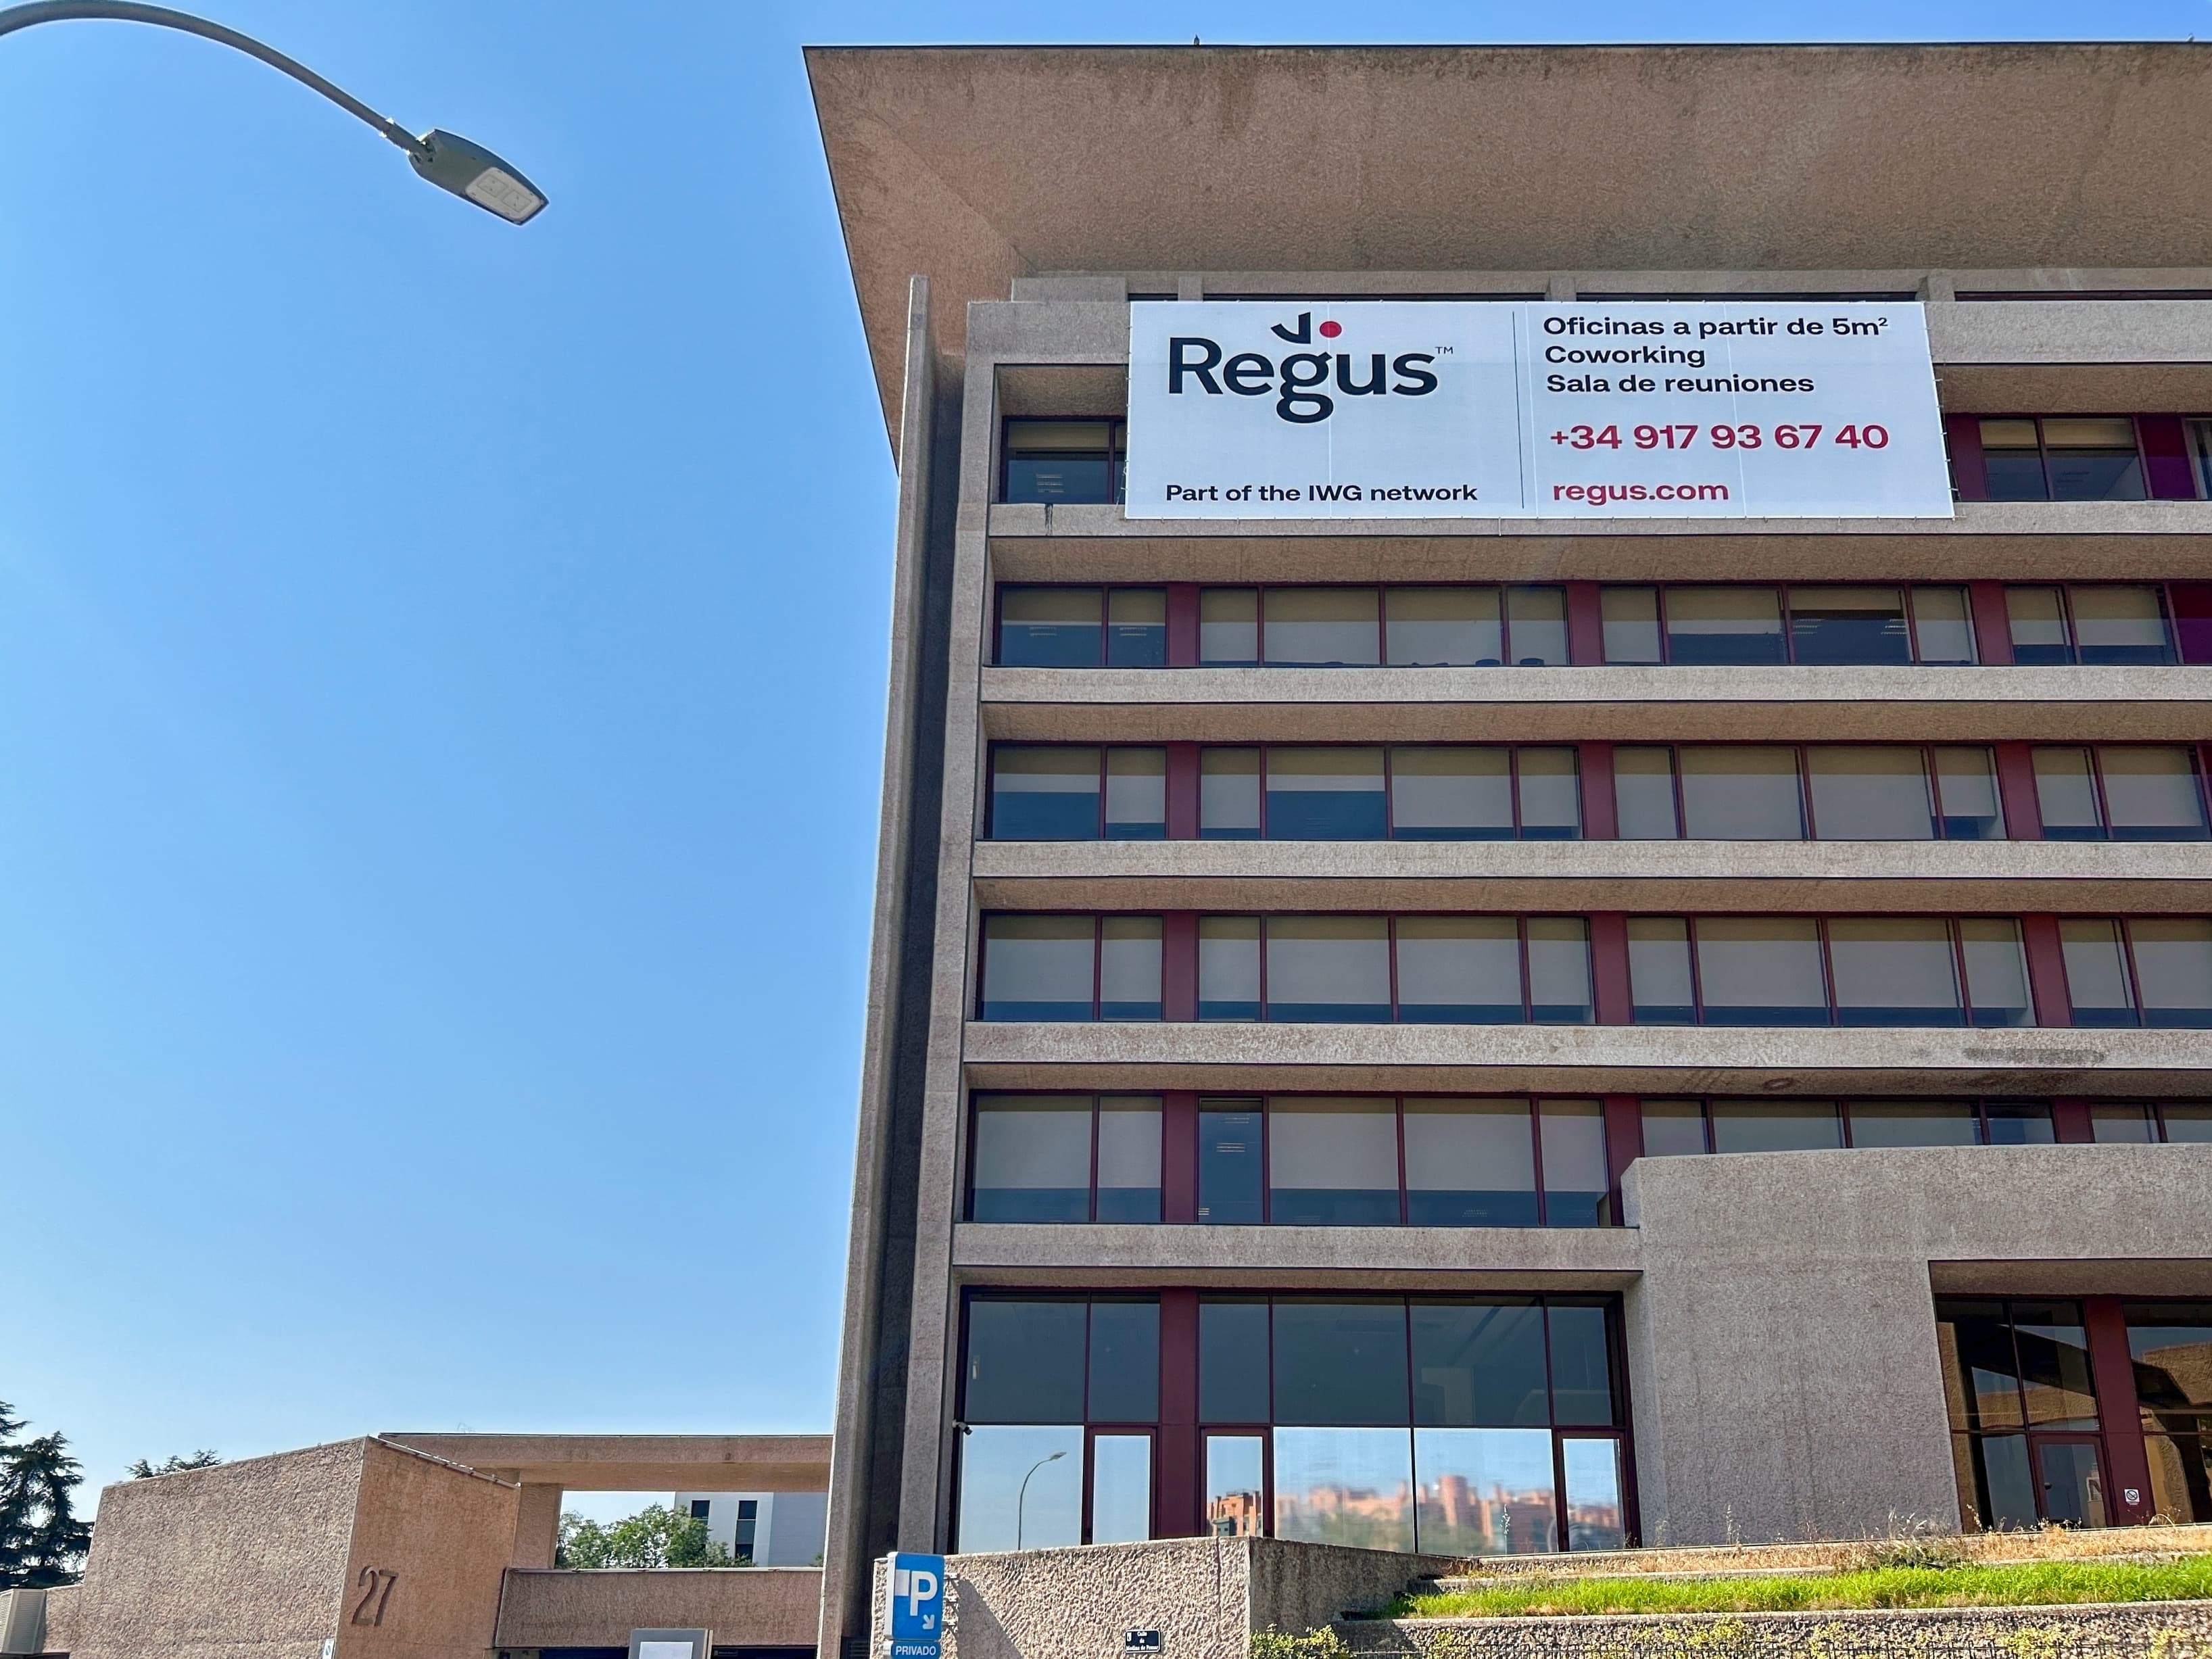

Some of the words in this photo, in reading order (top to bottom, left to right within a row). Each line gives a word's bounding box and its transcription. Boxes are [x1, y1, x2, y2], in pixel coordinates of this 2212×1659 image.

[1543, 316, 1664, 335] Oficinas
[1673, 322, 1691, 335] a
[1699, 317, 1778, 340] partir
[1787, 317, 1824, 335] de
[1832, 317, 1888, 336] 5m²
[1545, 345, 1706, 368] Coworking
[1547, 374, 1611, 393] Sala
[1618, 374, 1656, 392] de
[1664, 373, 1814, 392] reuniones
[1550, 425, 1622, 450] +34
[1633, 425, 1698, 450] 917
[1710, 425, 1762, 450] 93
[1774, 425, 1823, 449] 67
[1835, 425, 1889, 449] 40
[1166, 484, 1219, 501] Part
[1225, 484, 1252, 501] of
[1257, 484, 1301, 501] the
[1309, 485, 1362, 501] IWG
[1370, 484, 1478, 501] network
[1554, 485, 1729, 506] regus.com
[352, 1565, 399, 1627] 27
[909, 1570, 938, 1616] P
[895, 1645, 936, 1656] PRIVADO
